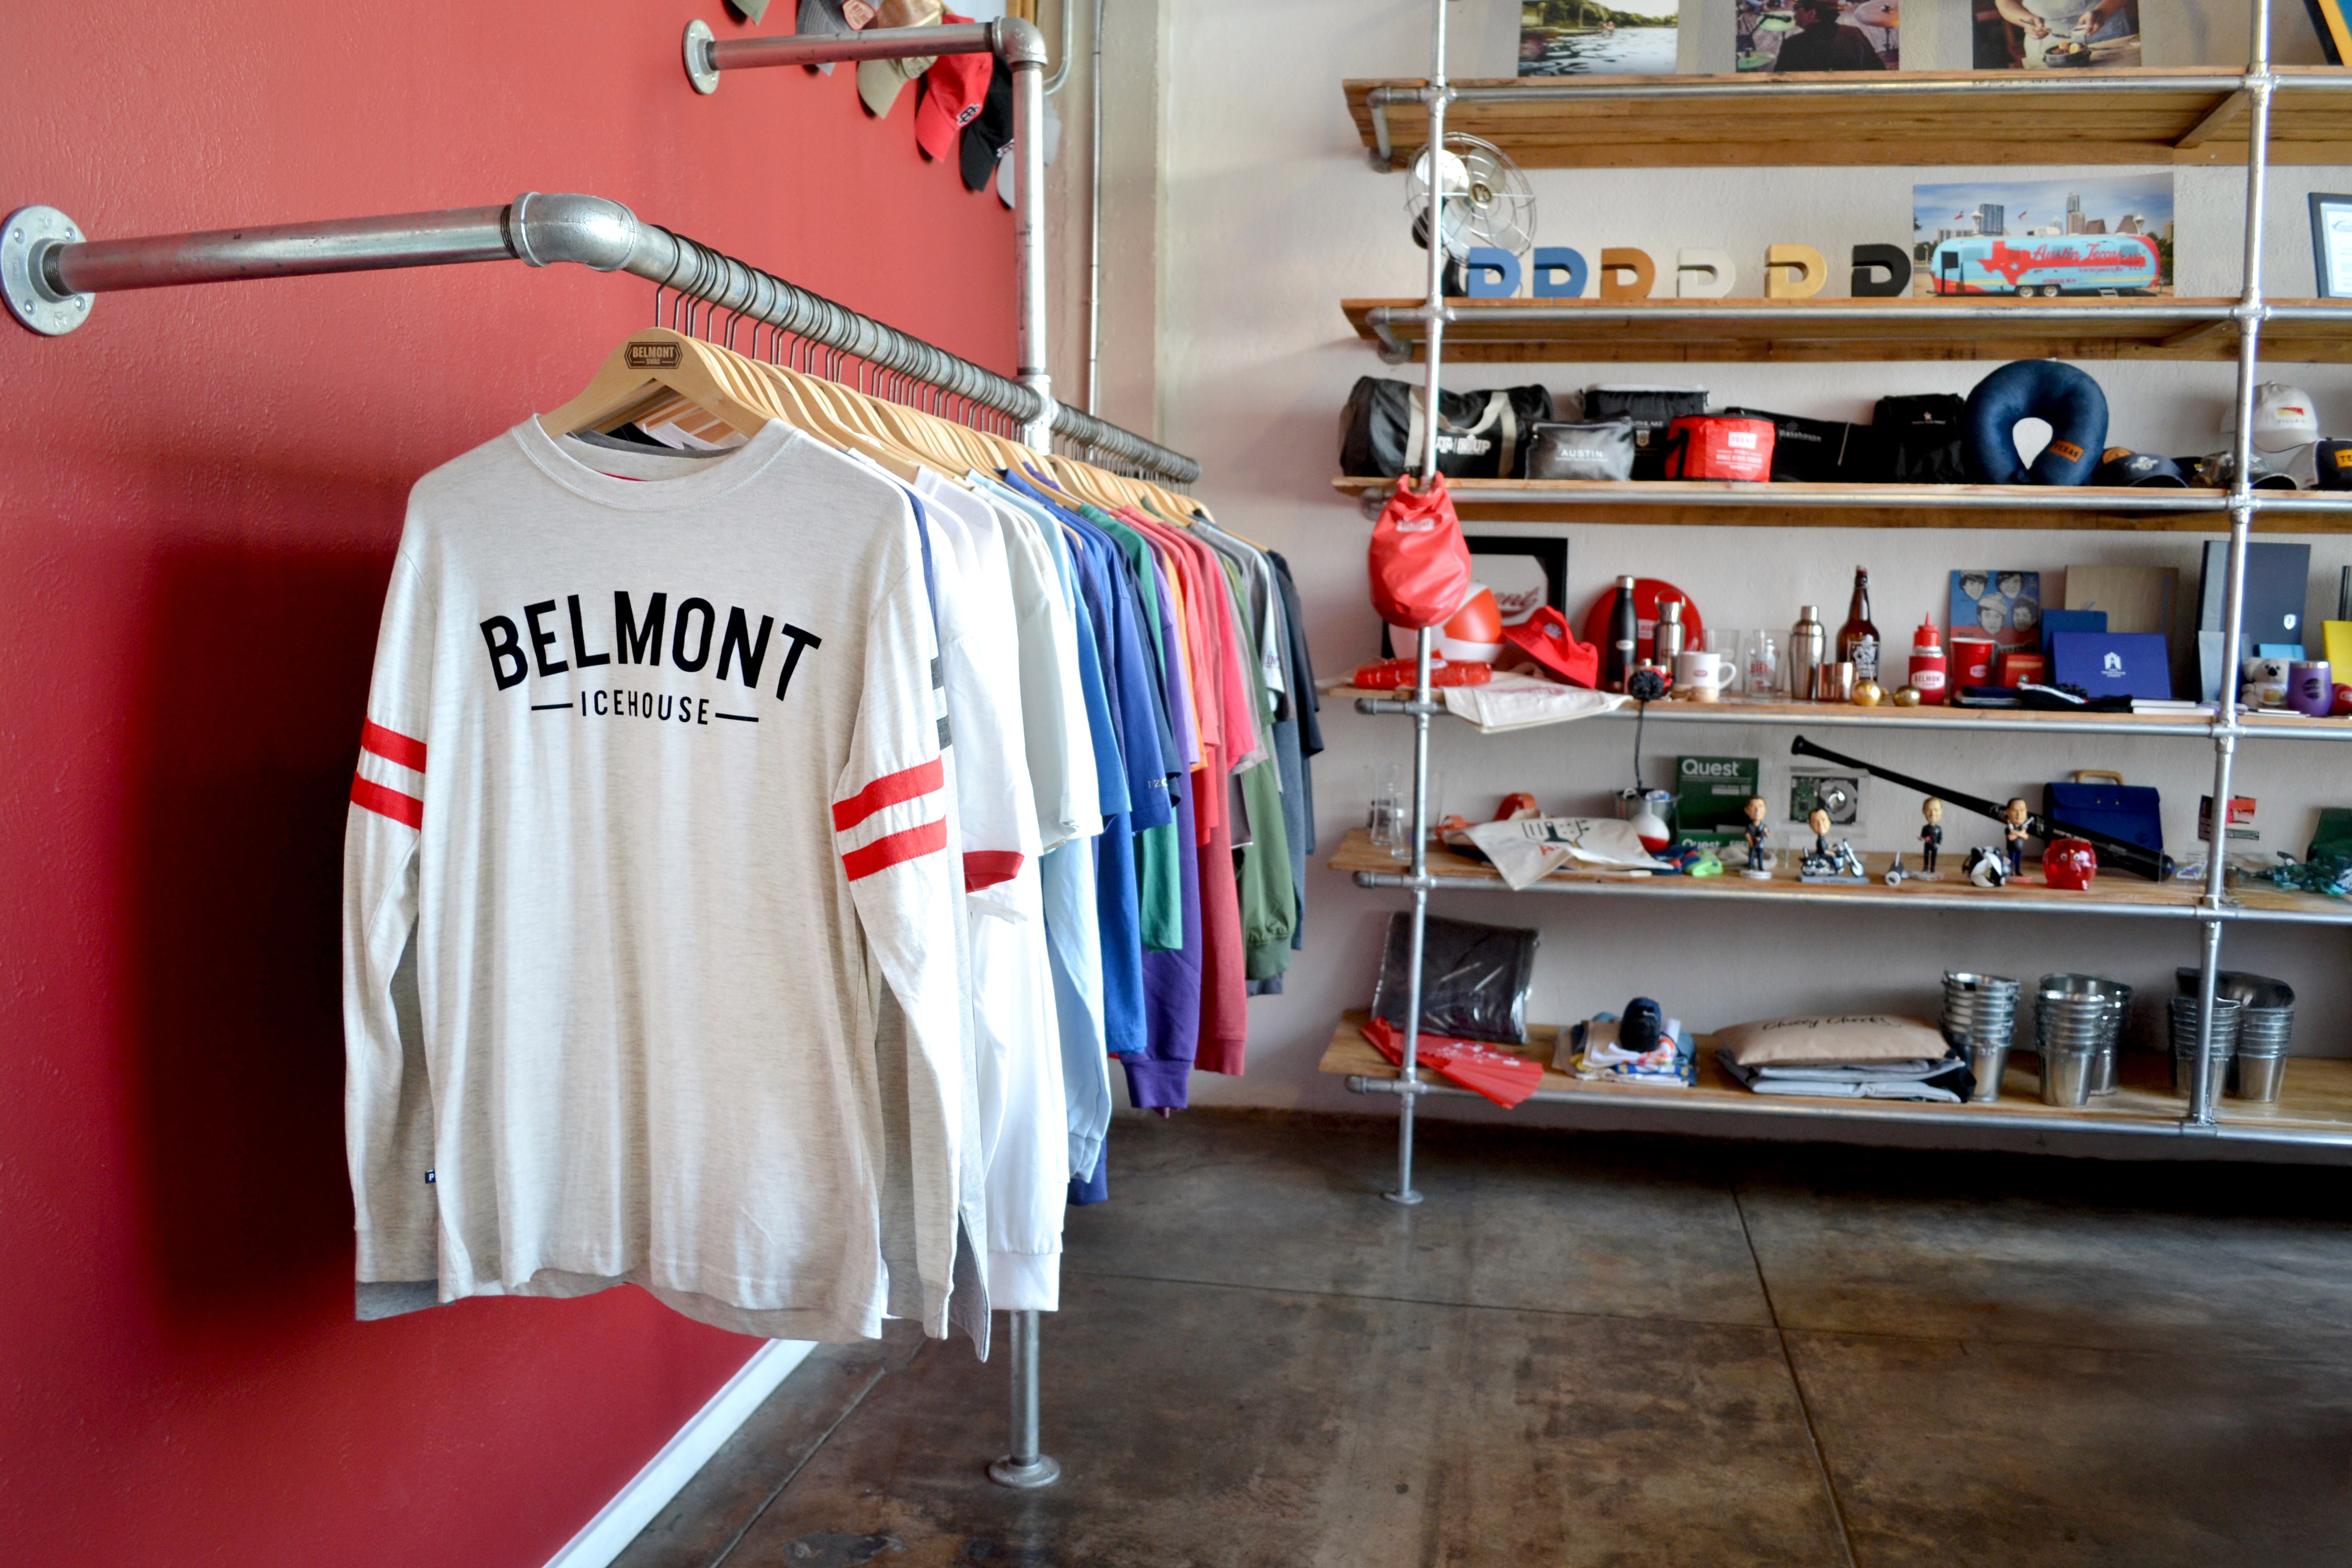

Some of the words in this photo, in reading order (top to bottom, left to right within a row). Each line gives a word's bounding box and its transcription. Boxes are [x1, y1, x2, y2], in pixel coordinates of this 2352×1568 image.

[633, 347, 674, 357] BELMONT
[1560, 449, 1603, 458] AUSTIN
[479, 591, 822, 701] BELMONT
[581, 690, 710, 725] ICEHOUSE
[1681, 758, 1739, 777] Quest
